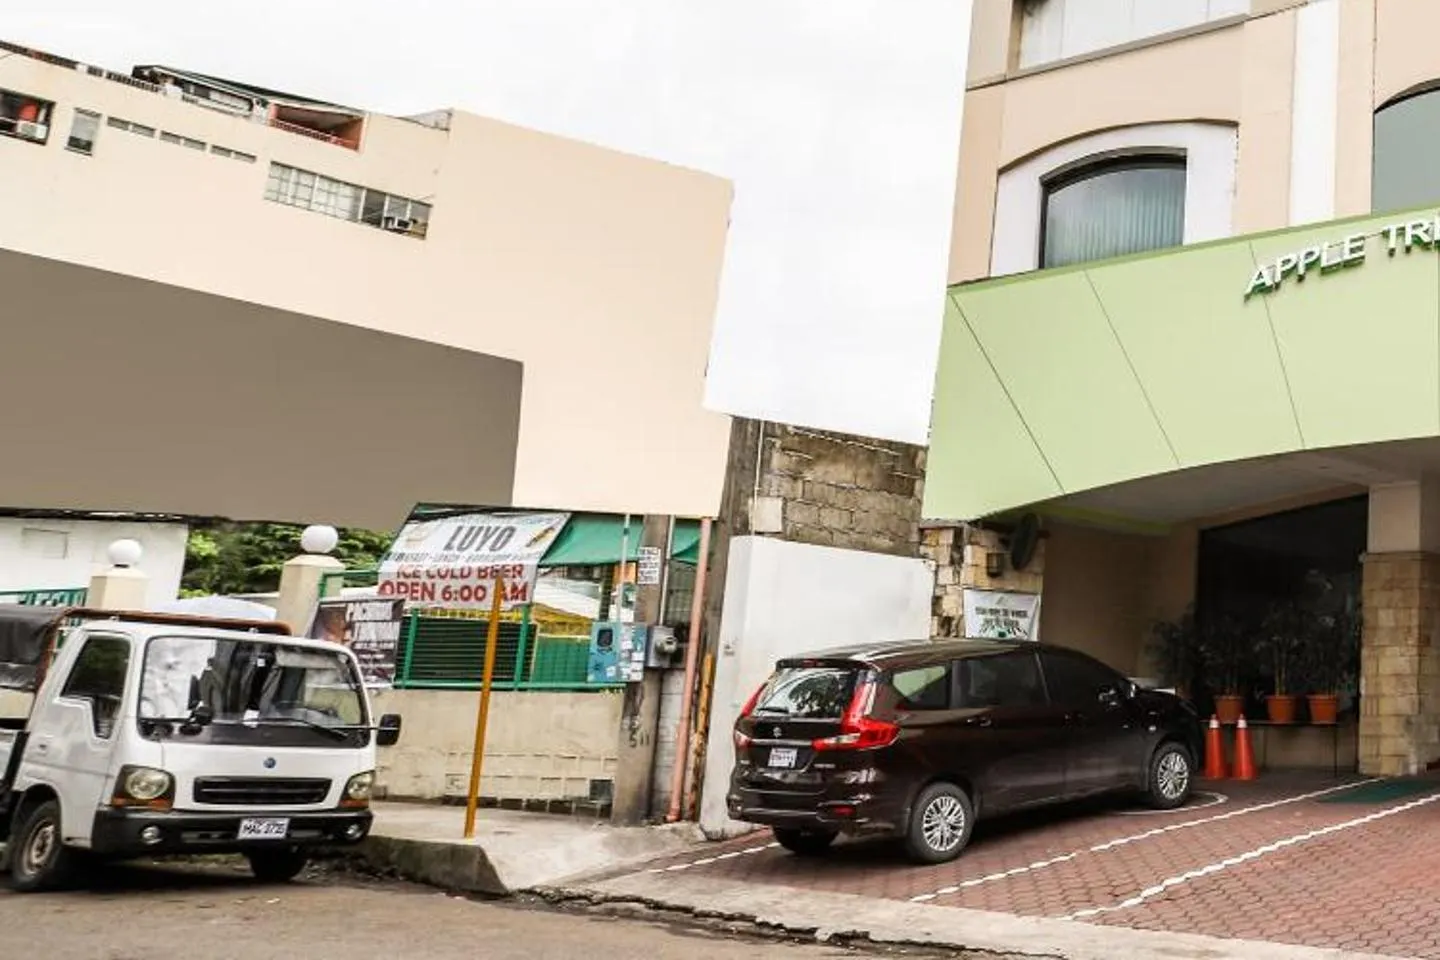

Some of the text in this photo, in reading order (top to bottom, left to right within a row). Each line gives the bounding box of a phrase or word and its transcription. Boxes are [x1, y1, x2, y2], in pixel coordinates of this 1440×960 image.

[1243, 234, 1366, 302] APPLE
[443, 525, 517, 552] LUYO
[396, 563, 524, 580] ICE COLD BEER
[378, 581, 529, 602] OPEN 6:00 AM
